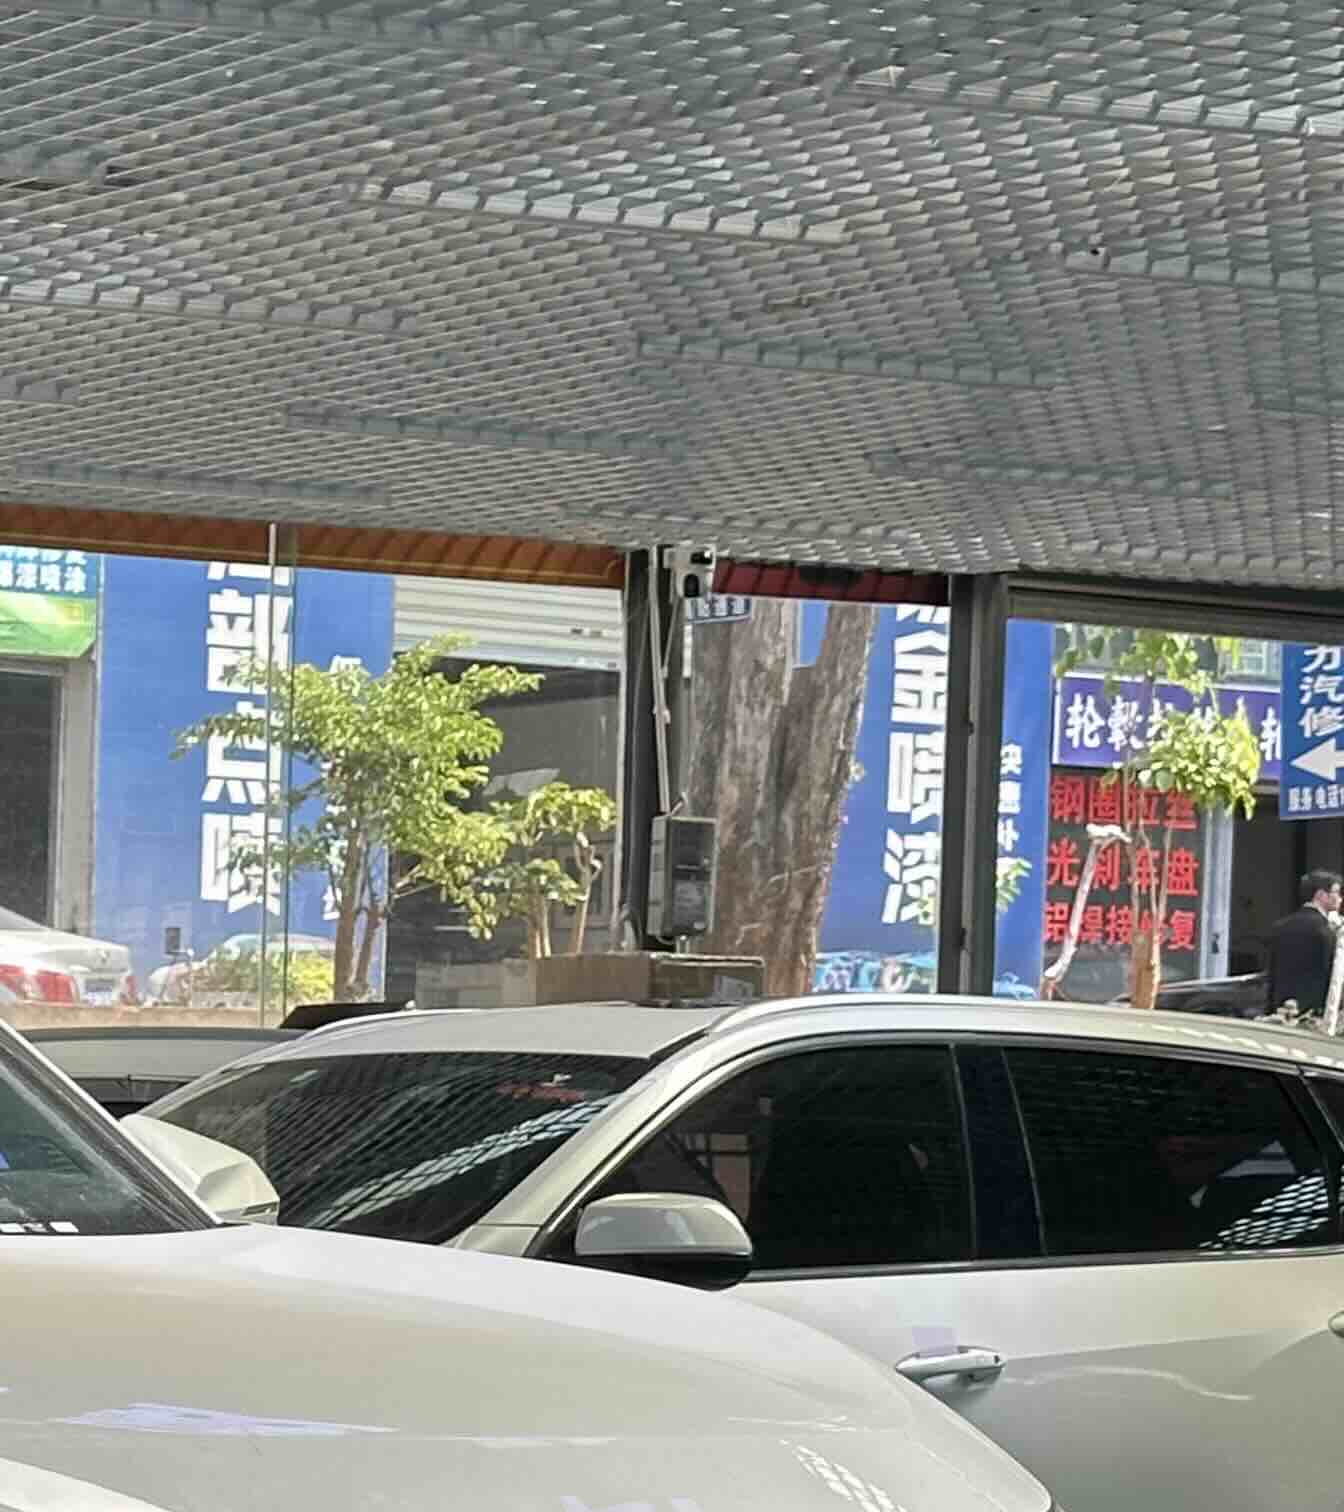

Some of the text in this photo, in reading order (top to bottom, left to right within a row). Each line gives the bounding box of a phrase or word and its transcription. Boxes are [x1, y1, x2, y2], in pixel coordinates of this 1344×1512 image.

[200, 561, 294, 915] 部点喷
[881, 604, 950, 924] 金喷漆
